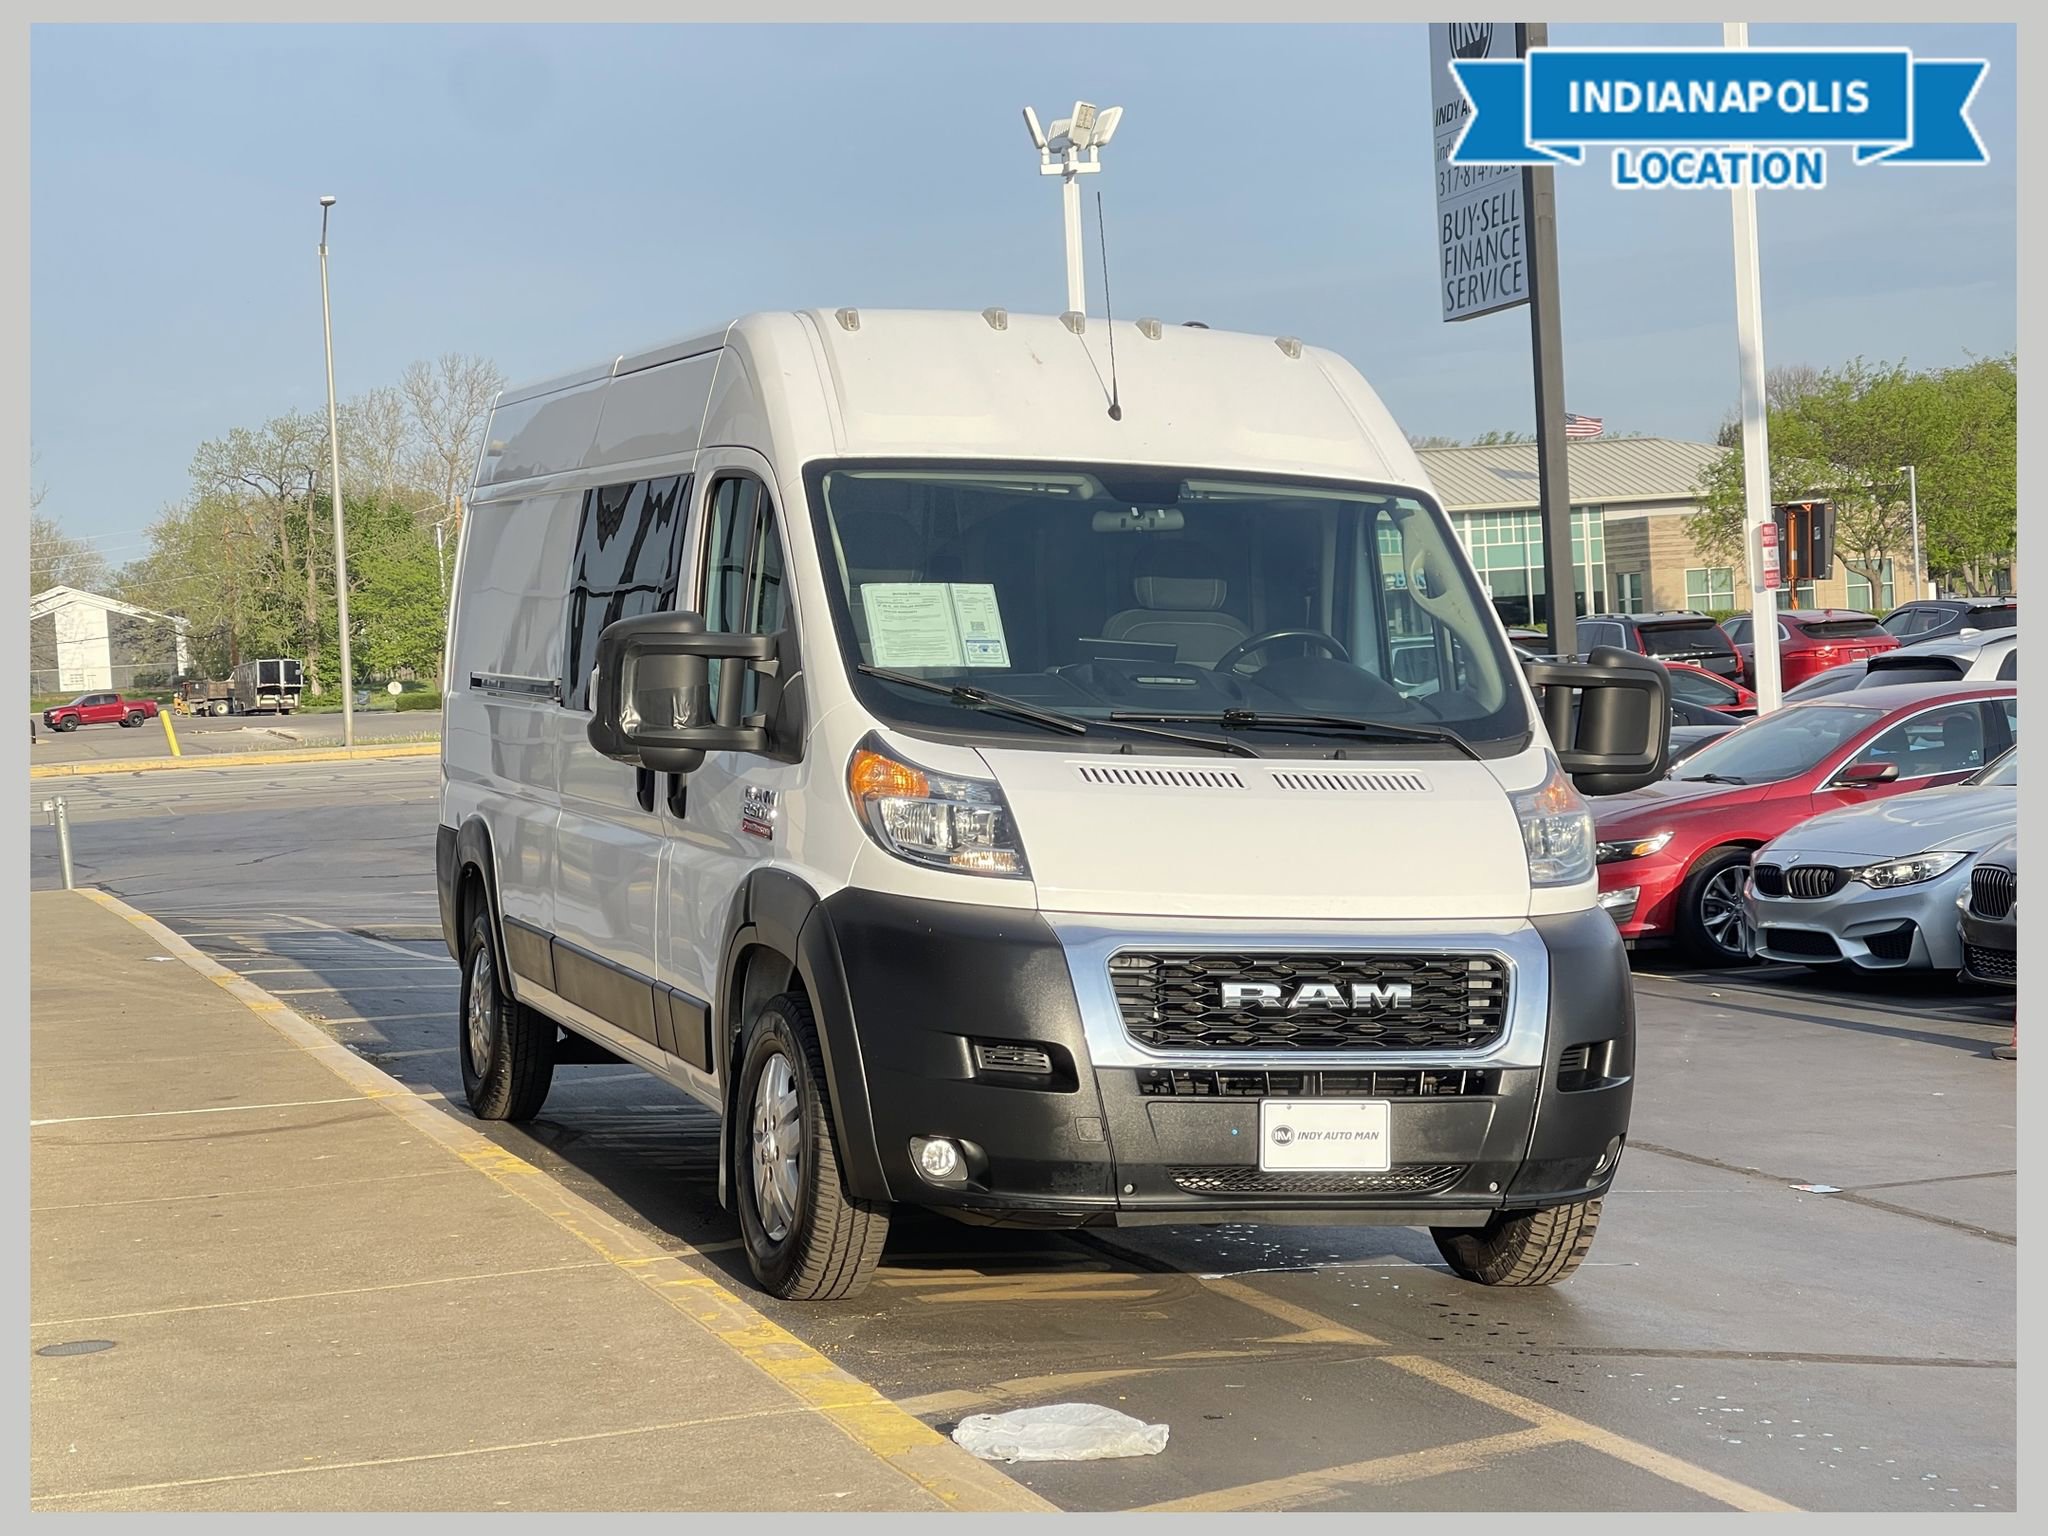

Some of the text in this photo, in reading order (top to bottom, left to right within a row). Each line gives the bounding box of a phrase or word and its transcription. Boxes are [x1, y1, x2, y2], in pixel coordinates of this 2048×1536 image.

[1435, 99, 1460, 127] INDY
[1444, 224, 1521, 279] FINANCE
[1446, 260, 1523, 312] SERVICE
[1221, 982, 1413, 1009] RAM
[1297, 1131, 1323, 1141] INDY
[1323, 1131, 1352, 1141] AUTO
[1354, 1131, 1380, 1141] MAN
